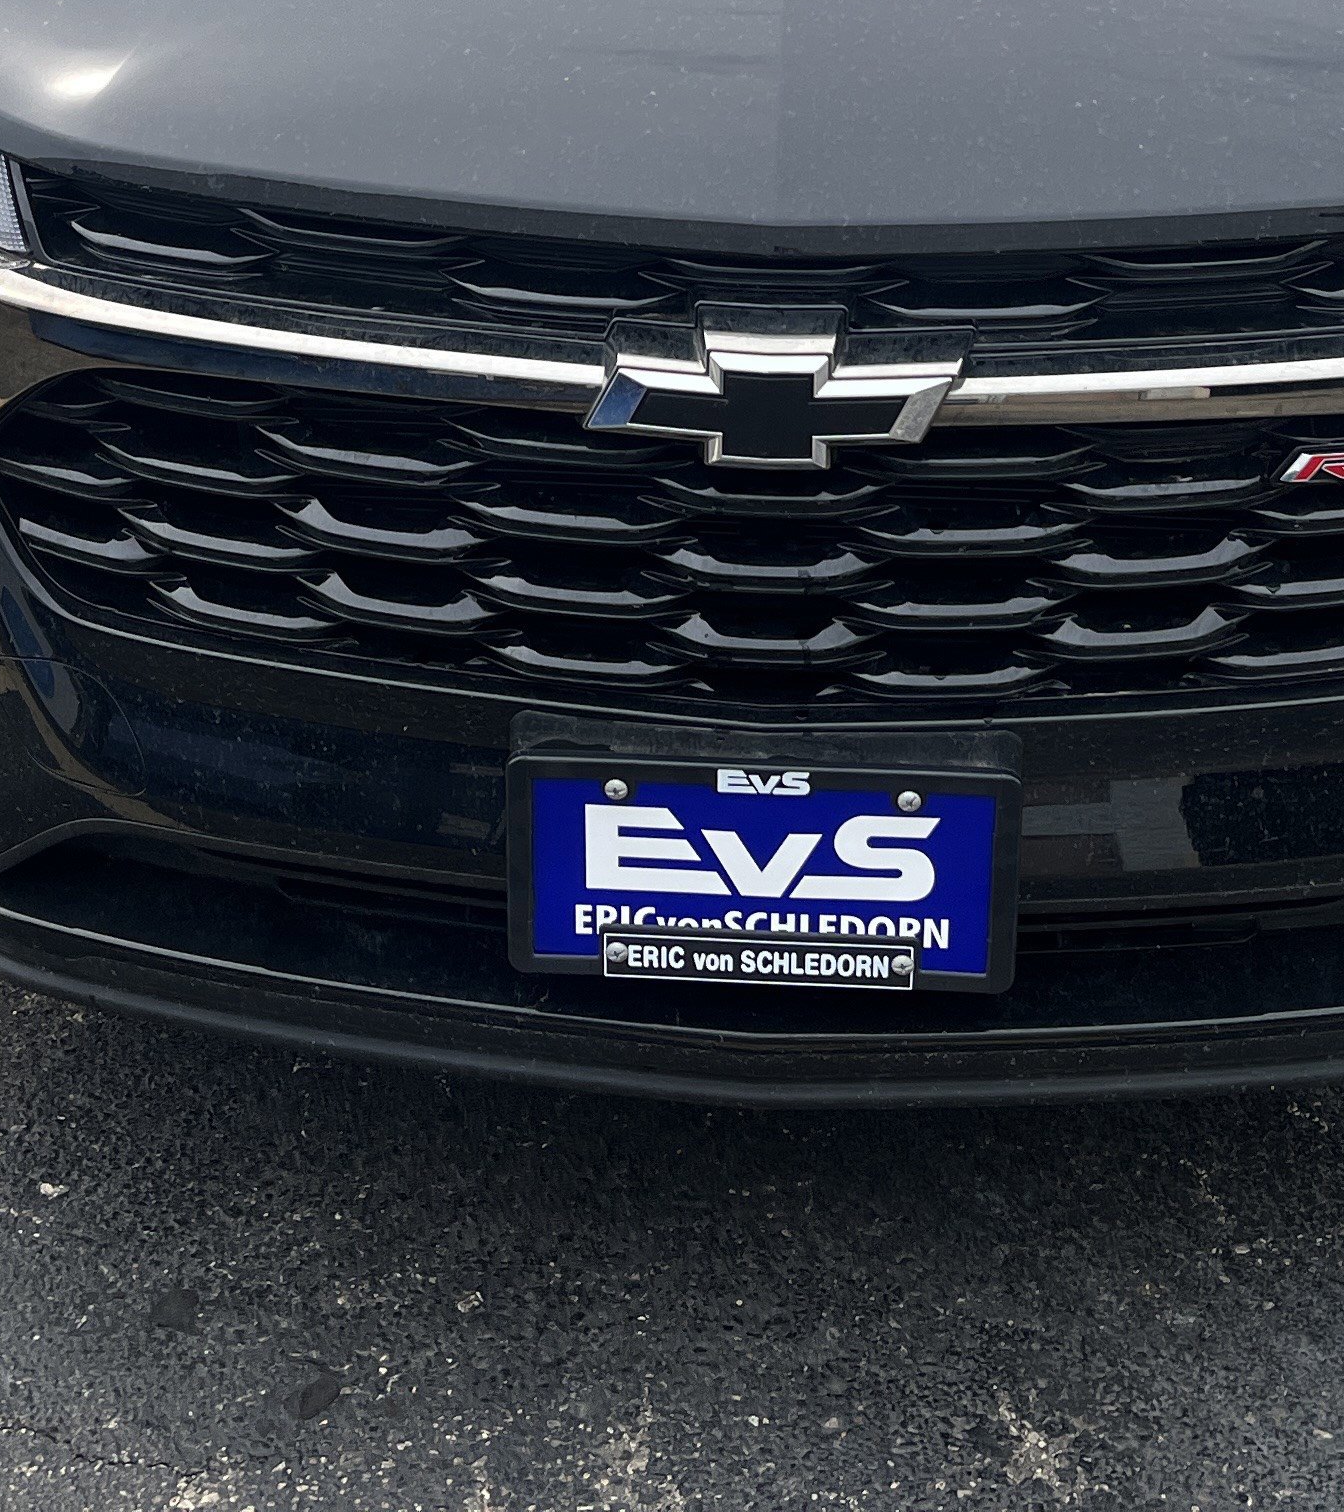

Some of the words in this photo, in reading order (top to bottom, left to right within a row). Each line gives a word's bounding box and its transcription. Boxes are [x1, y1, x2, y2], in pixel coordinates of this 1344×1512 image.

[627, 944, 685, 969] ERIC
[693, 952, 733, 972] von
[740, 949, 889, 978] SCHLEDORN
